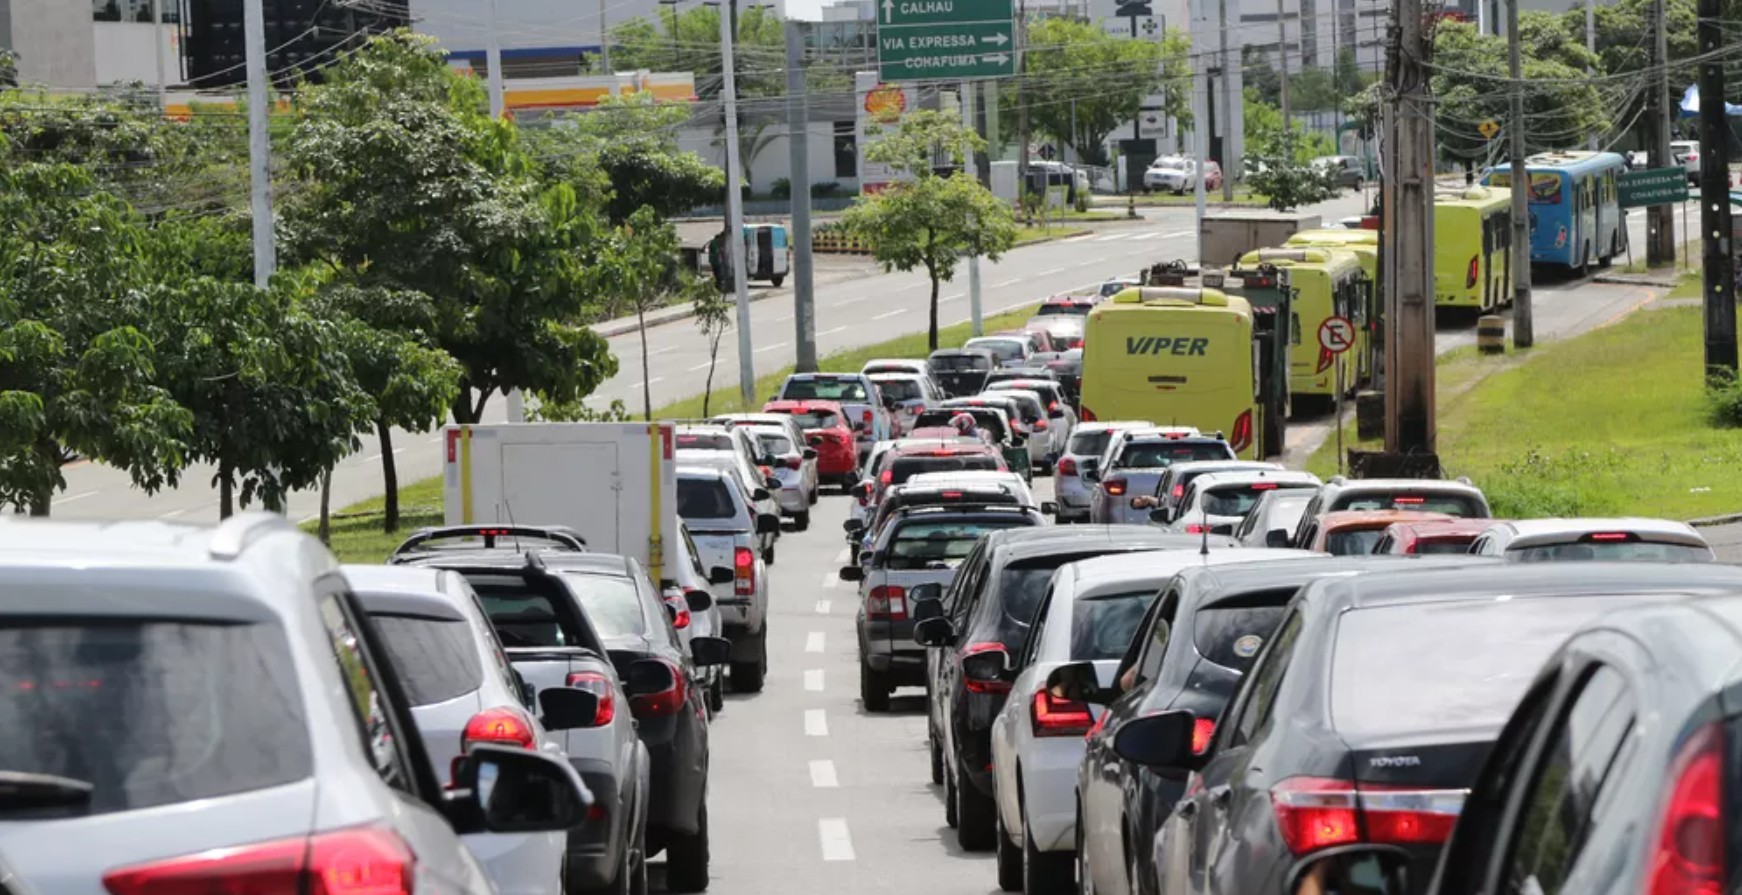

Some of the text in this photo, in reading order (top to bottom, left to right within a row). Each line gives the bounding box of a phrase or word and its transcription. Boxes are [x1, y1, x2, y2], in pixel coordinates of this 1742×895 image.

[900, 1, 953, 15] CALHAU
[883, 34, 976, 50] VIA EXPRESSA
[904, 54, 977, 69] COHAFUMA
[1329, 325, 1343, 345] E
[1126, 336, 1209, 356] VIPER
[1369, 755, 1421, 768] TOYOTA
